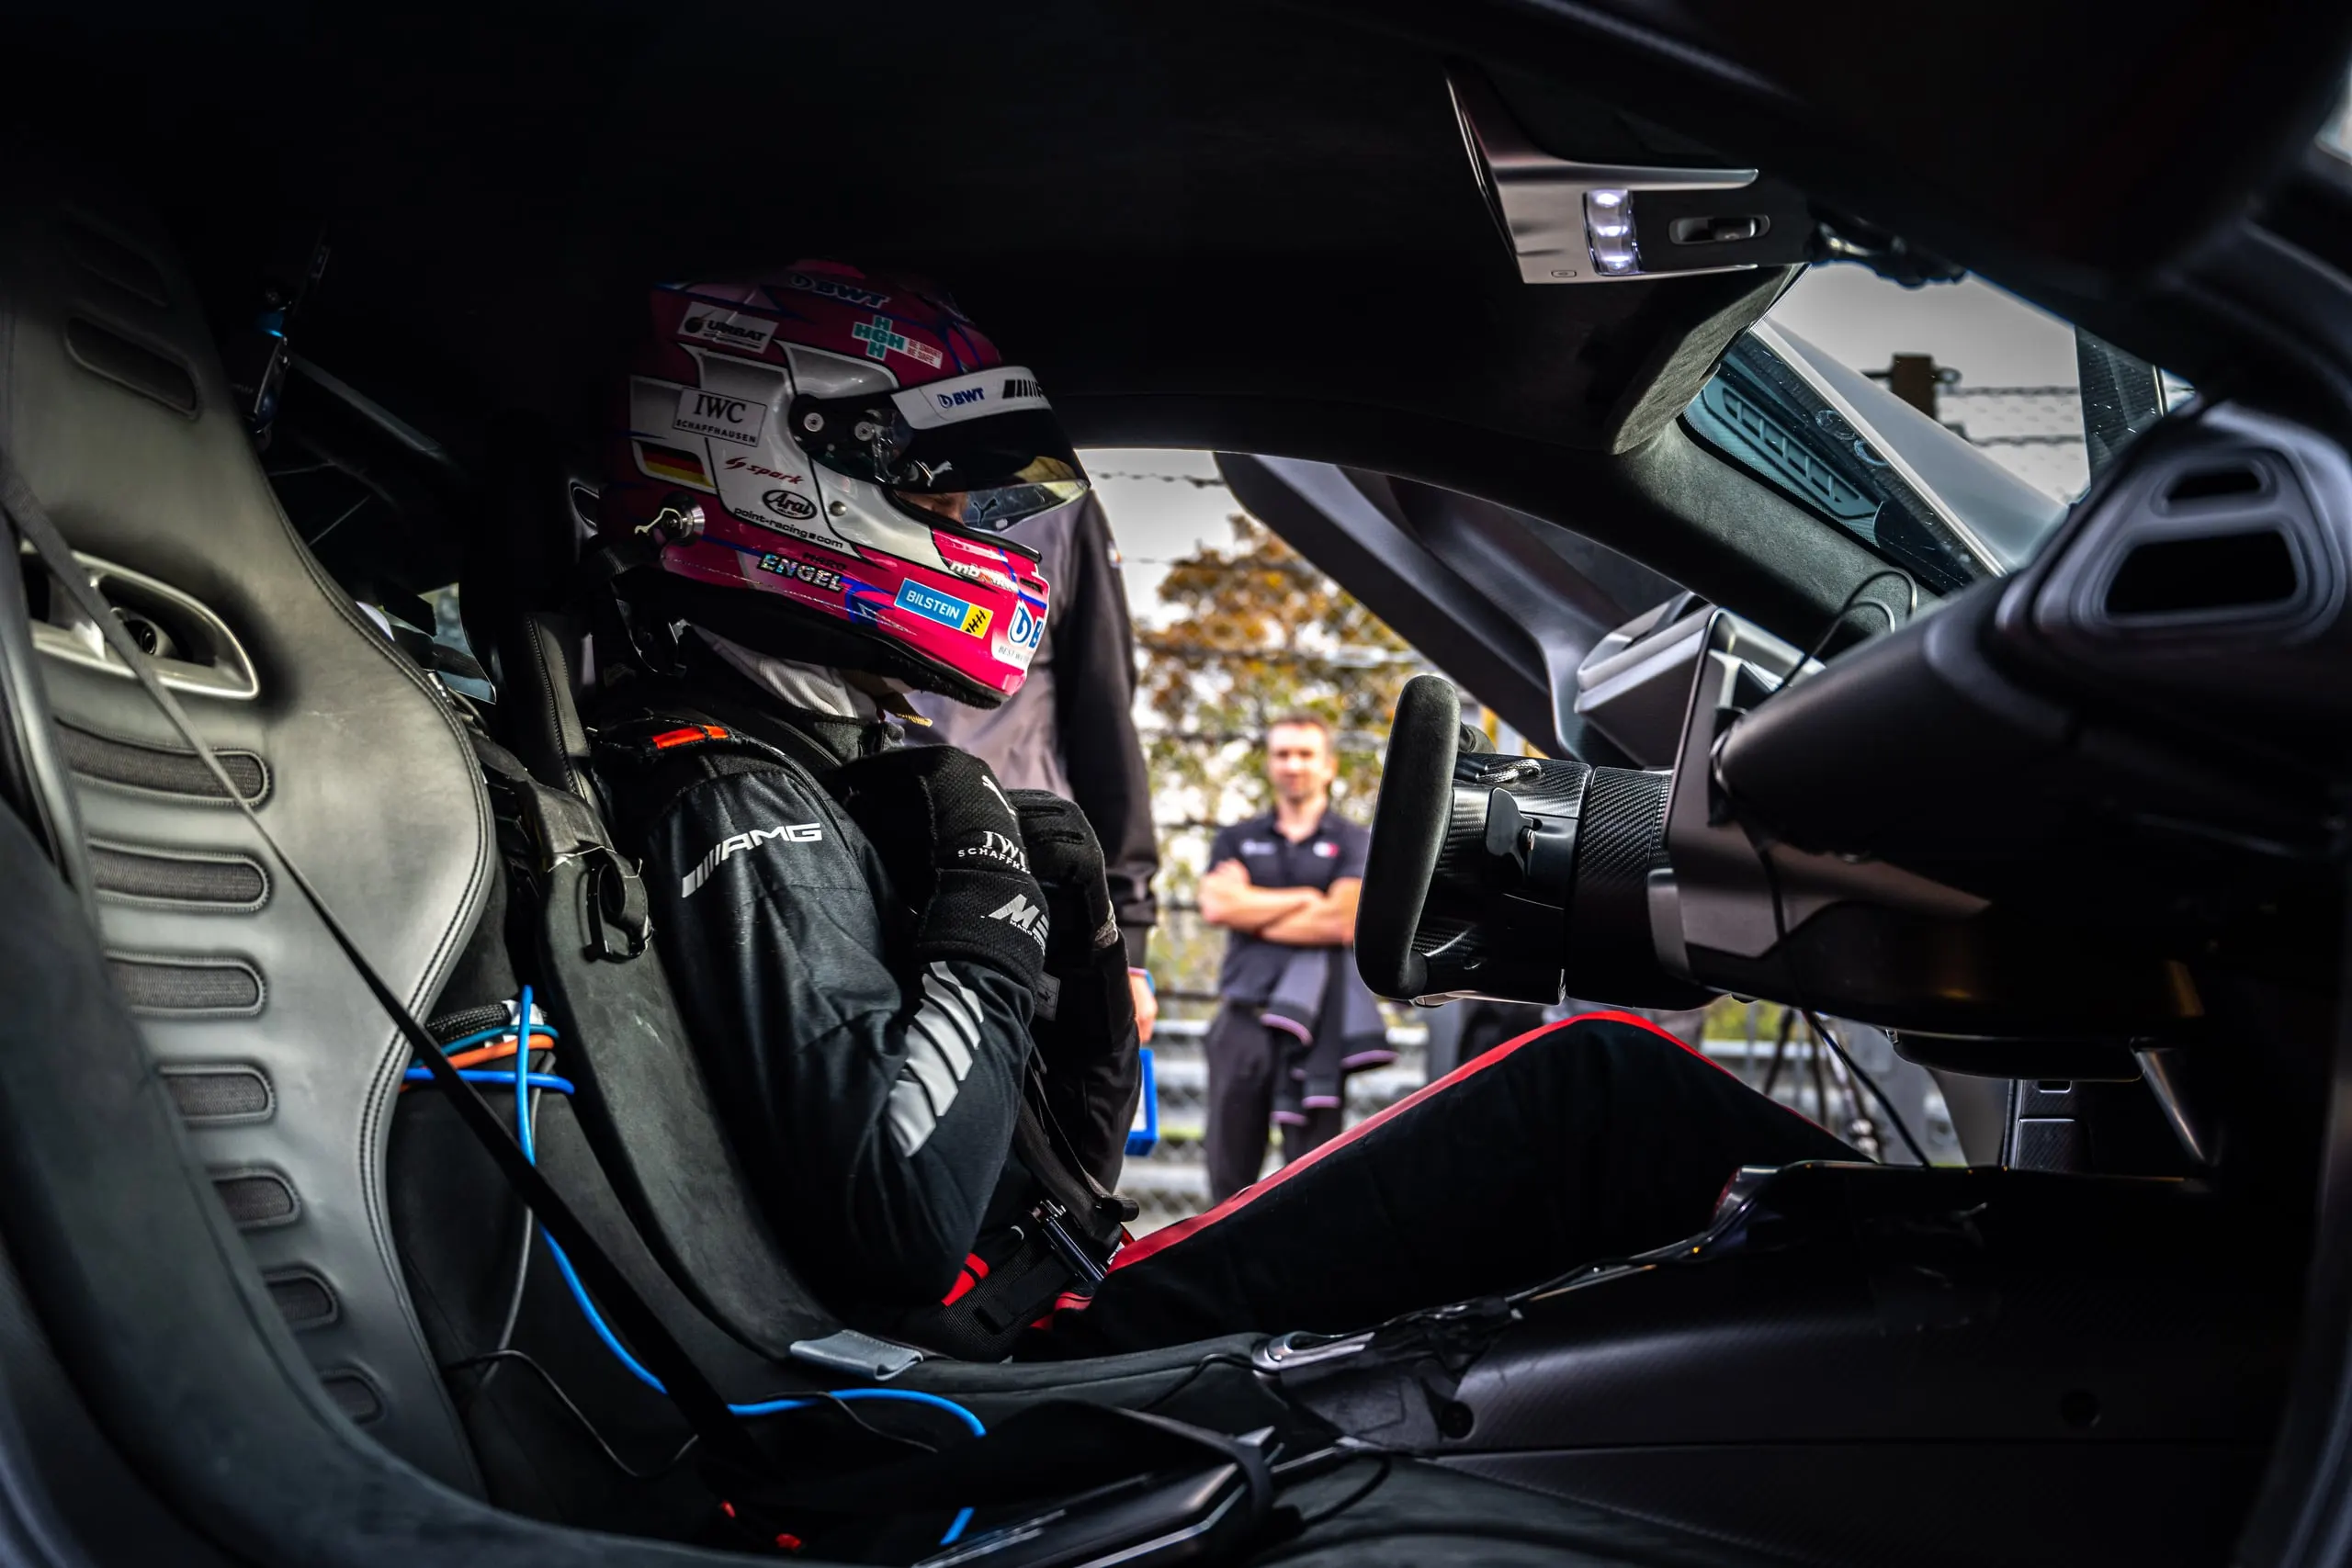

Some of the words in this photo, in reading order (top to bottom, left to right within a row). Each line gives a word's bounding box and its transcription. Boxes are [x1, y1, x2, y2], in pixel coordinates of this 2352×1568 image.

[814, 278, 892, 310] BWT
[707, 319, 767, 342] URBAT
[694, 394, 746, 423] IWC
[952, 387, 985, 406] BWT
[675, 419, 756, 443] SCHAFFHAUSEN
[746, 465, 803, 484] spark
[767, 492, 811, 515] Arai
[758, 552, 843, 592] ENGEL
[906, 589, 961, 621] BILSTEIN
